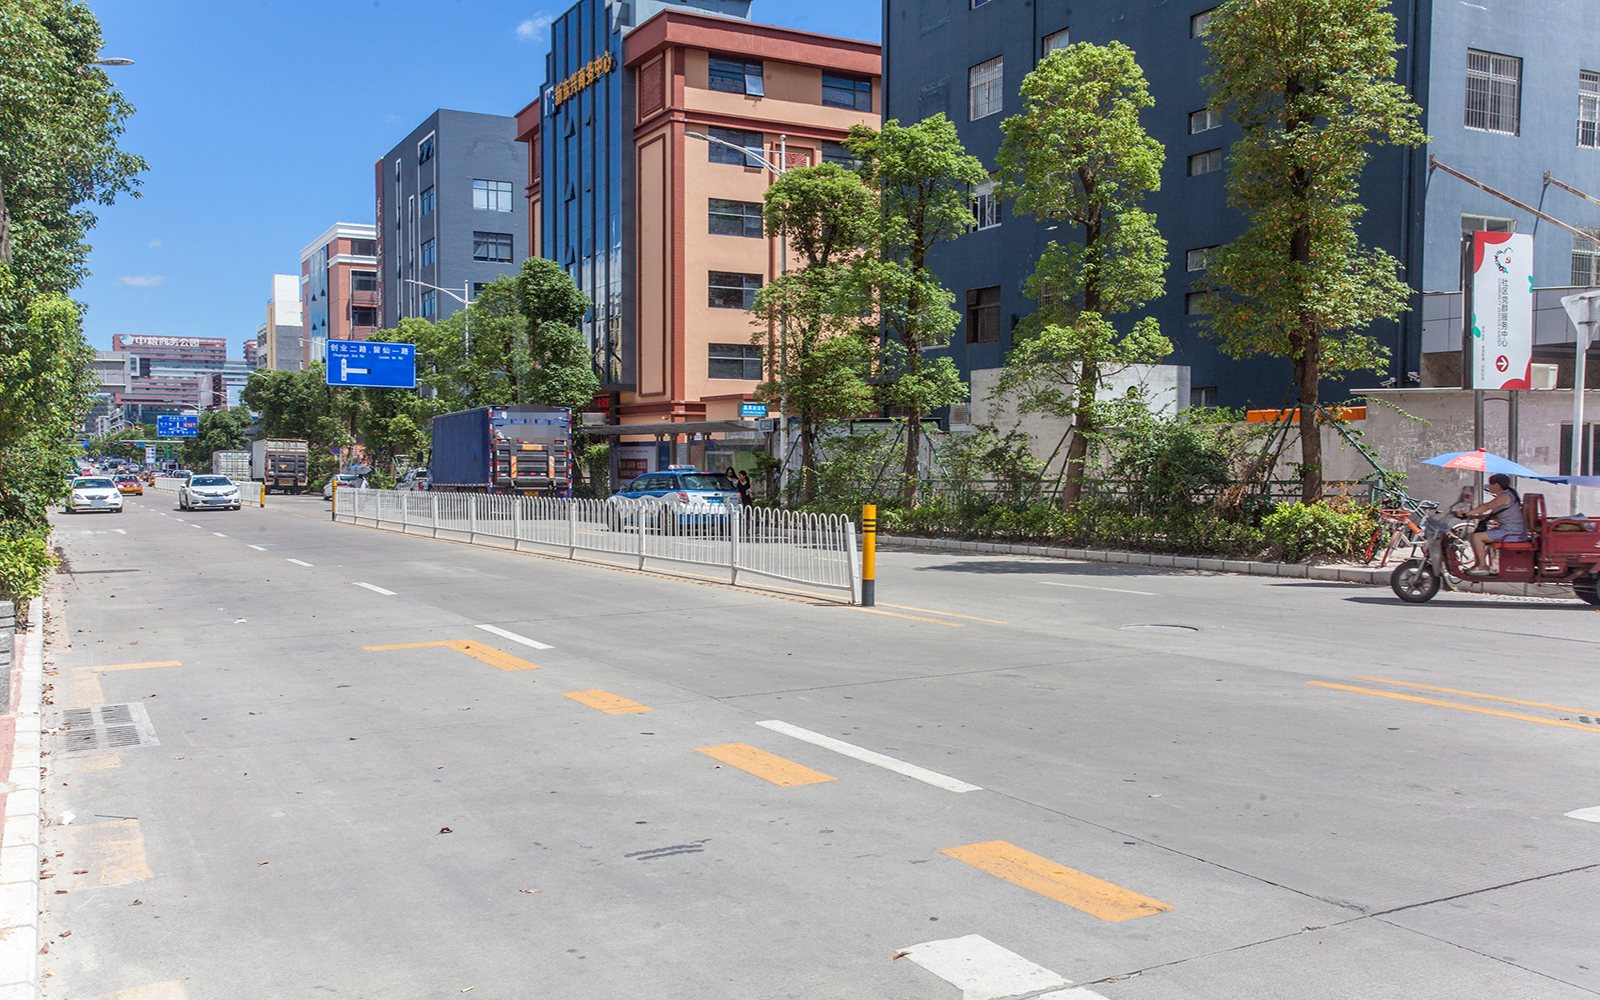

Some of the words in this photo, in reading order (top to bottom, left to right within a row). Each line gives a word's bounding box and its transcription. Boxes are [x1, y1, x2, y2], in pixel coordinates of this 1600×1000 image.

[135, 336, 199, 347] 中粮商务公园
